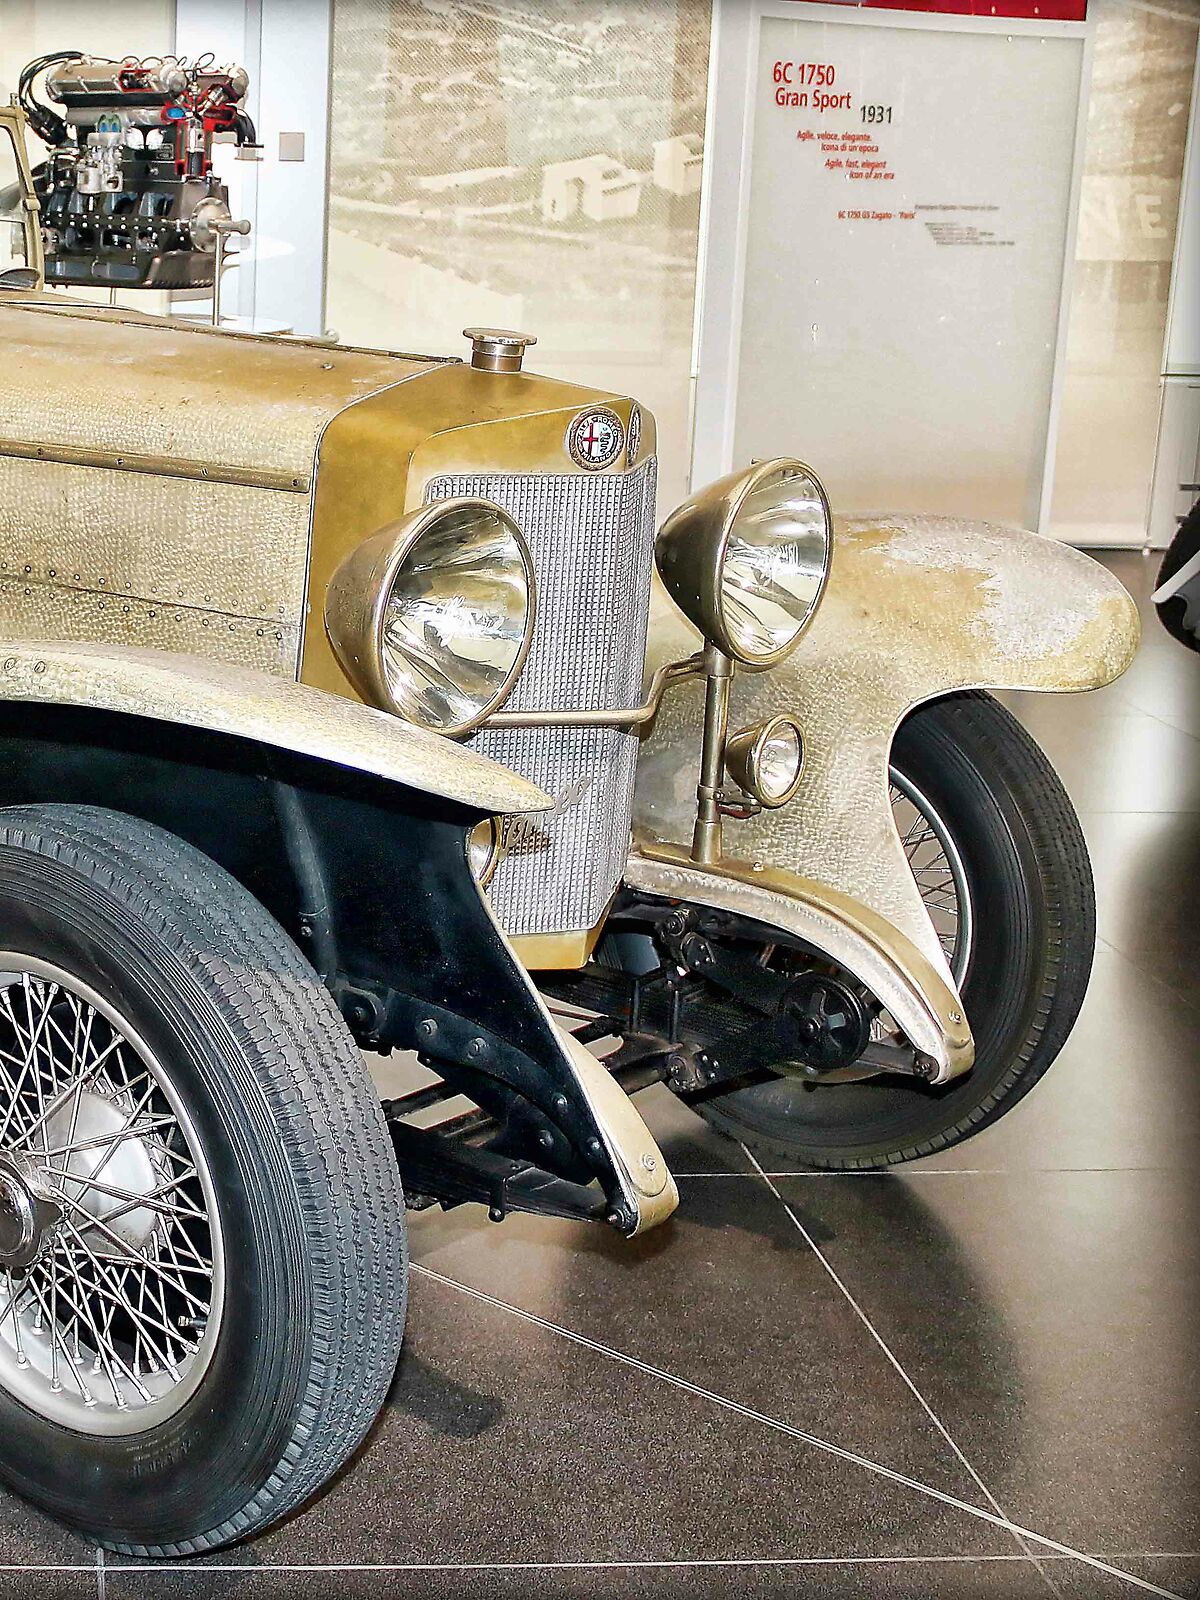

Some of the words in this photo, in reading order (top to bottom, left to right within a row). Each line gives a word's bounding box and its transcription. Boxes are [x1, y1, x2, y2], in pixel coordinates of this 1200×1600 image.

[773, 61, 793, 84] 6C
[798, 63, 836, 86] 1750
[775, 87, 808, 107] Gran
[812, 89, 852, 113] Sport
[860, 104, 893, 124] 1931
[840, 143, 847, 152] di
[861, 160, 887, 170] elegant
[883, 172, 895, 180] era
[580, 451, 612, 463] MILANO
